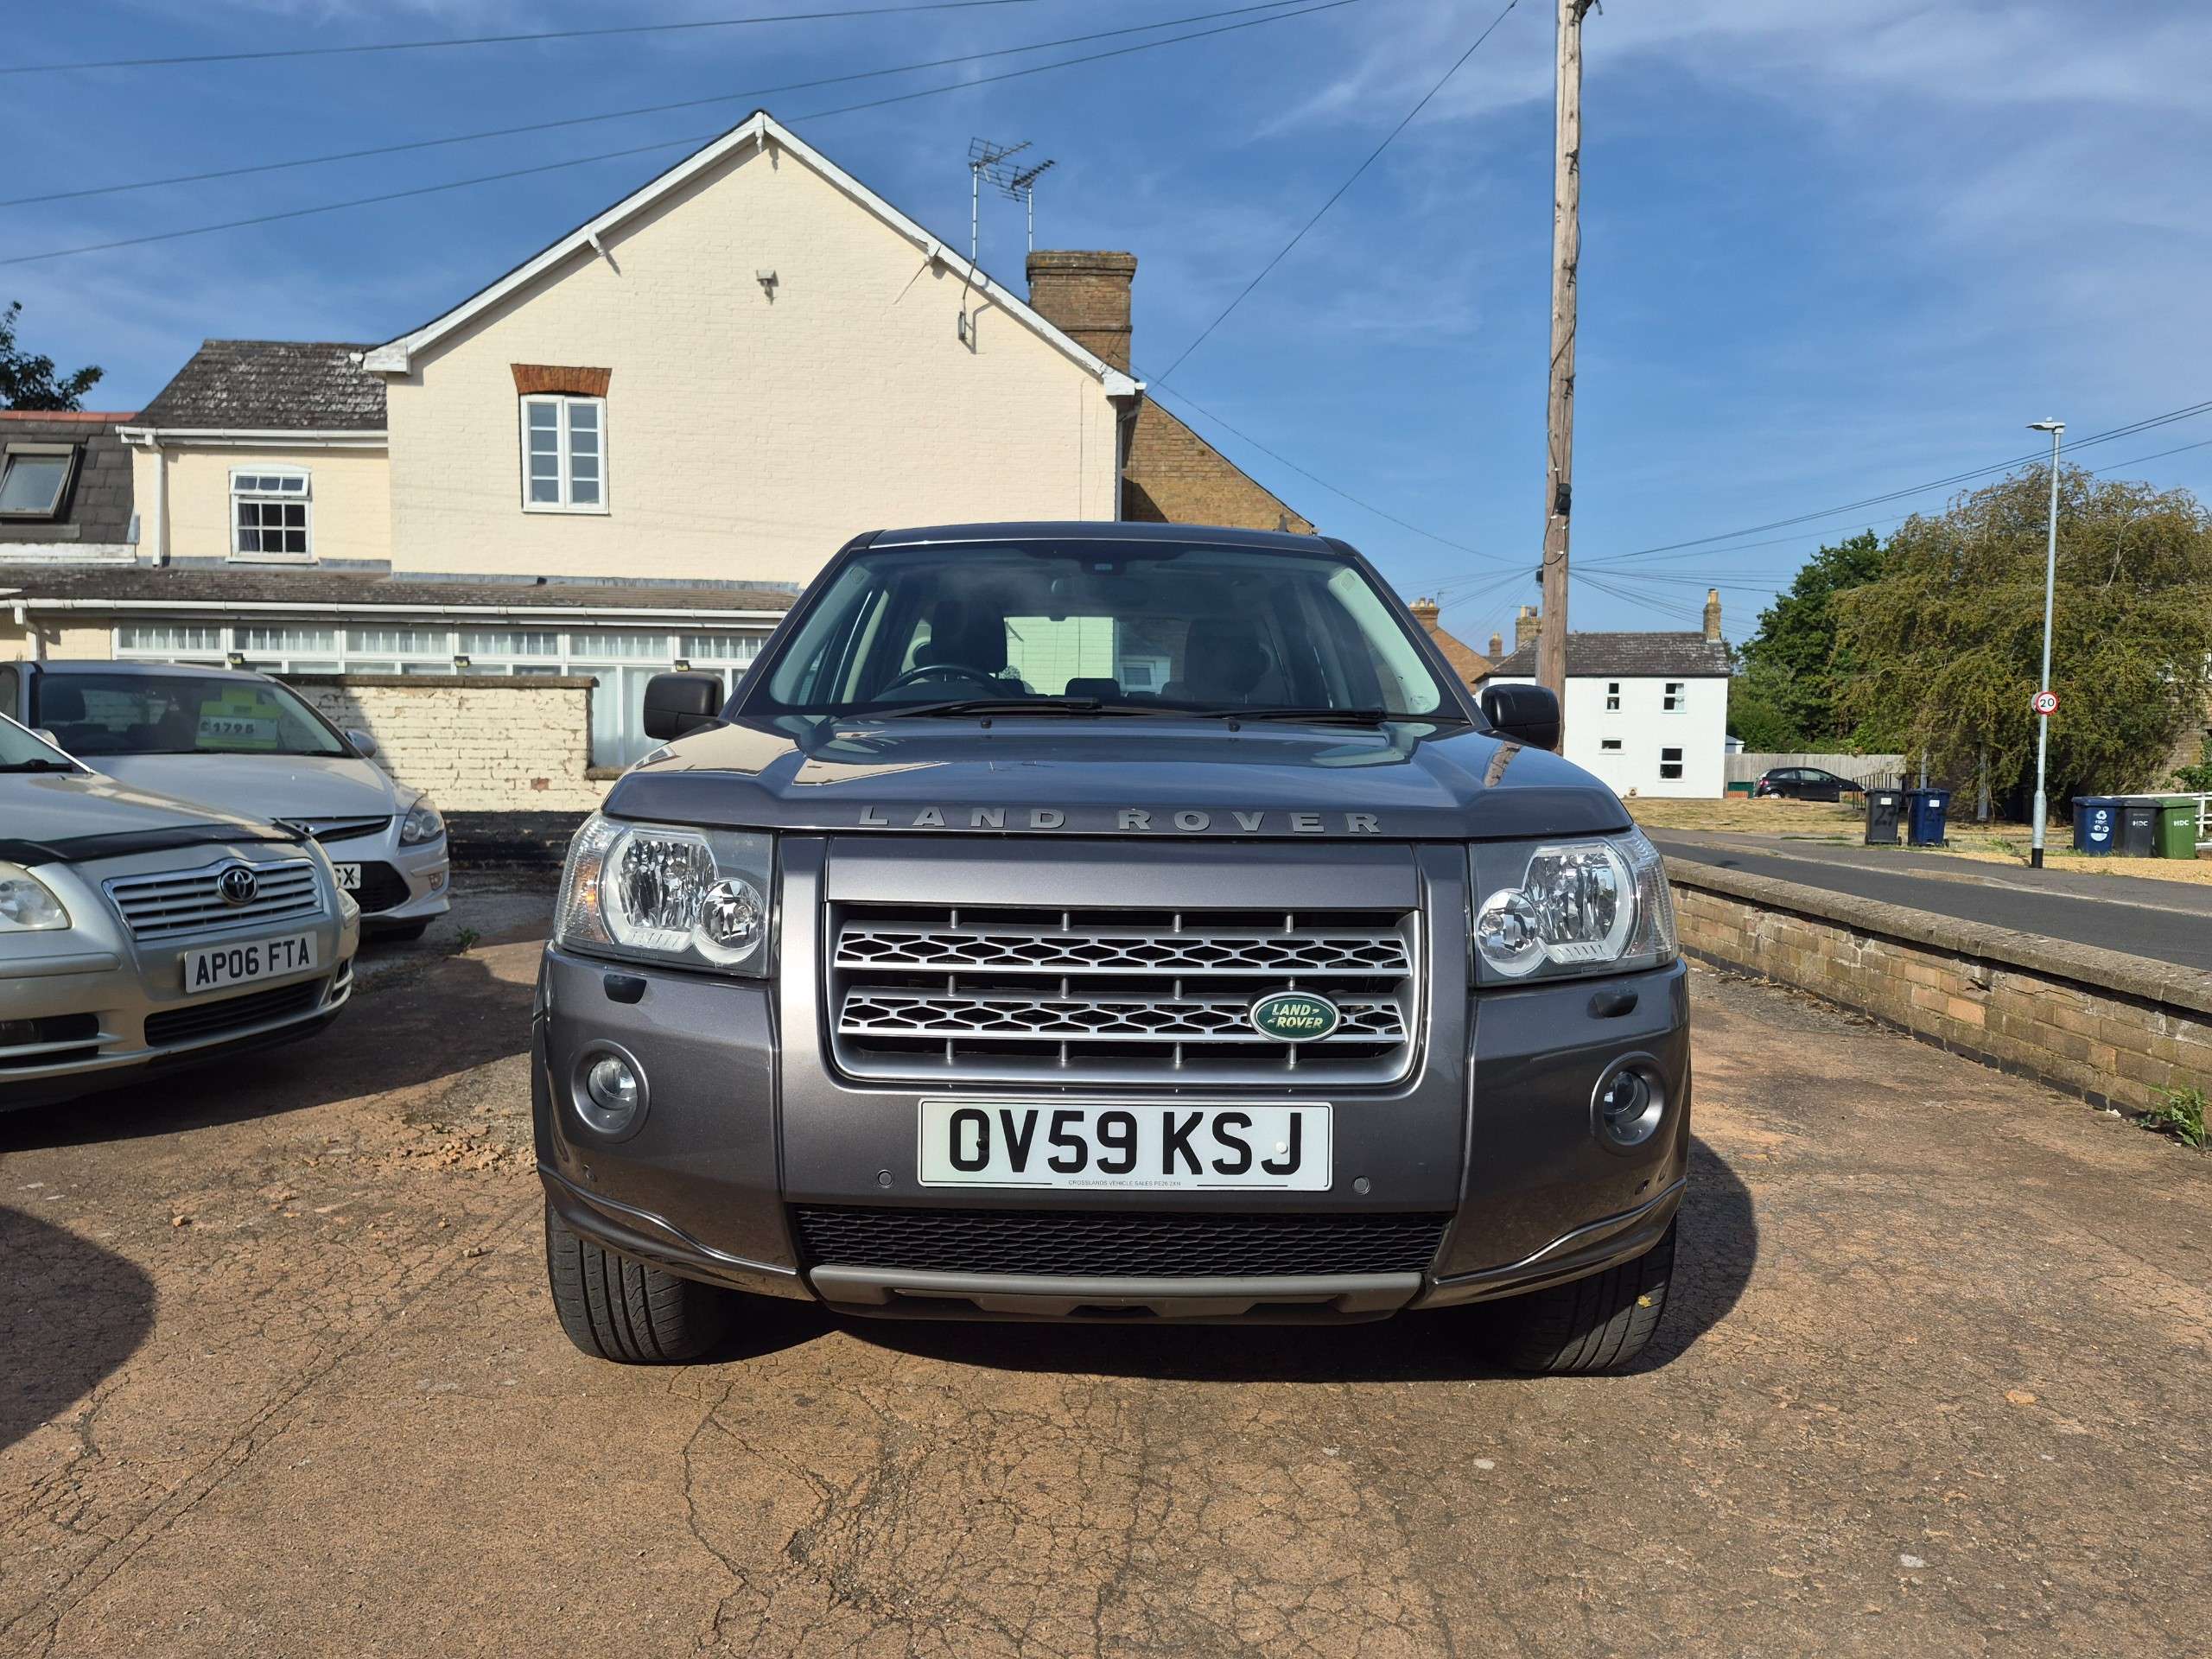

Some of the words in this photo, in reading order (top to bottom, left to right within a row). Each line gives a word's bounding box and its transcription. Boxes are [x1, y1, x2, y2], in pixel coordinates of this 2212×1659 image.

[2040, 698, 2055, 707] 20
[858, 804, 1065, 830] LAND
[1119, 808, 1382, 834] ROVER
[196, 946, 259, 986] AP06
[269, 938, 309, 971] FTA
[1272, 1003, 1311, 1015] LAND
[1276, 1016, 1324, 1028] ROVER
[950, 1108, 1138, 1174] OV59
[1162, 1111, 1302, 1176] KSJ
